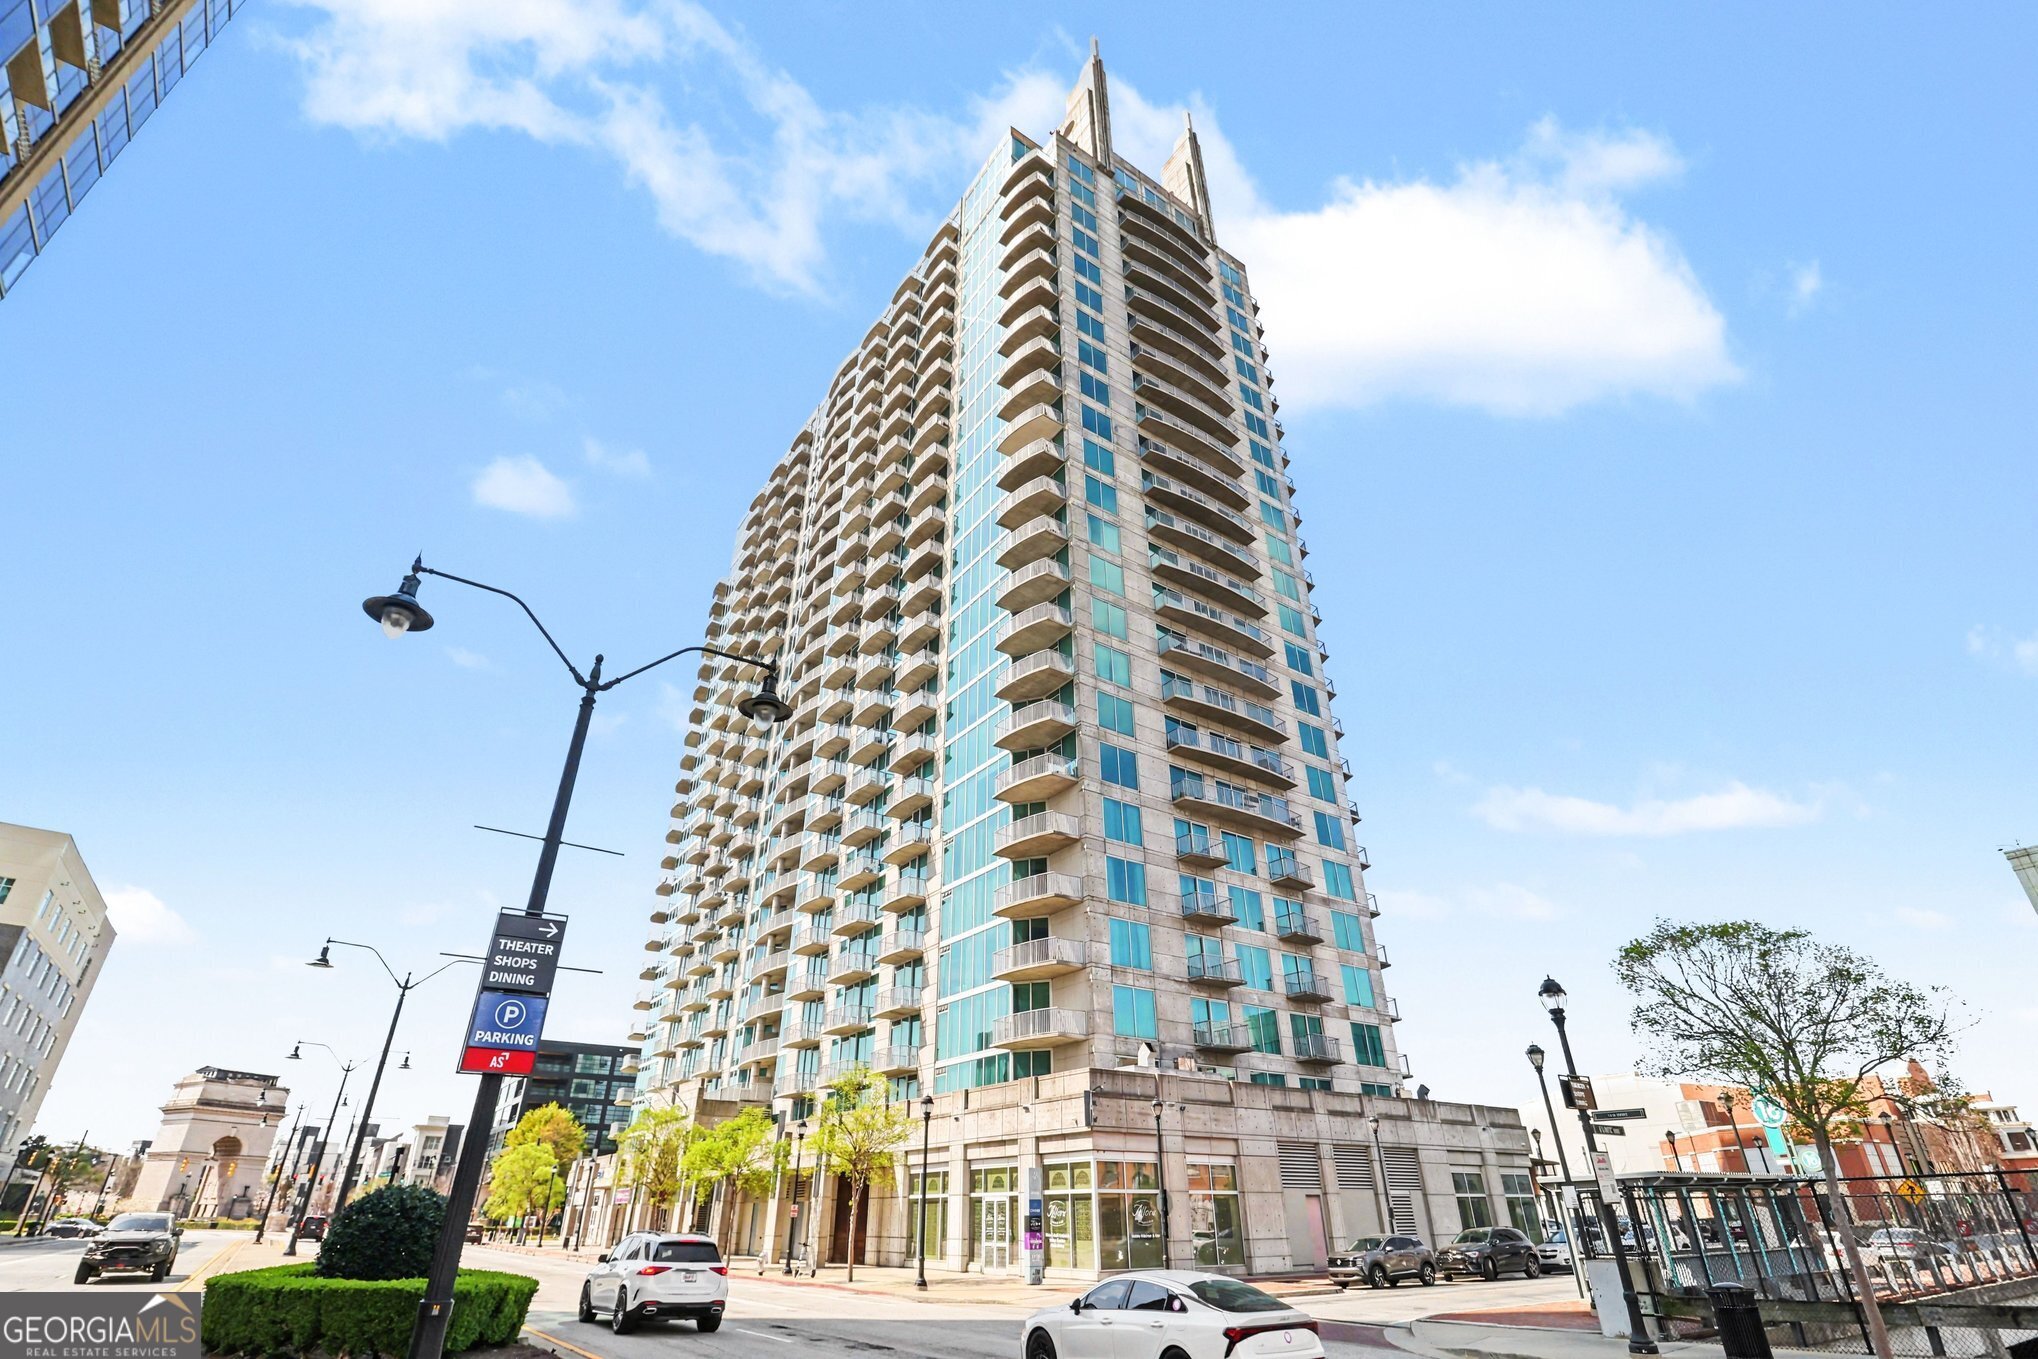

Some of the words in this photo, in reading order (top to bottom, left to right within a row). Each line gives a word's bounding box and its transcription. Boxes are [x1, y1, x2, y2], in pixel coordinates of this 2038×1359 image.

[499, 939, 554, 956] THEATER
[493, 955, 538, 970] SHOPS
[489, 971, 535, 986] DINING
[503, 1005, 520, 1023] P
[474, 1030, 535, 1046] PARKING
[489, 1055, 504, 1068] AS
